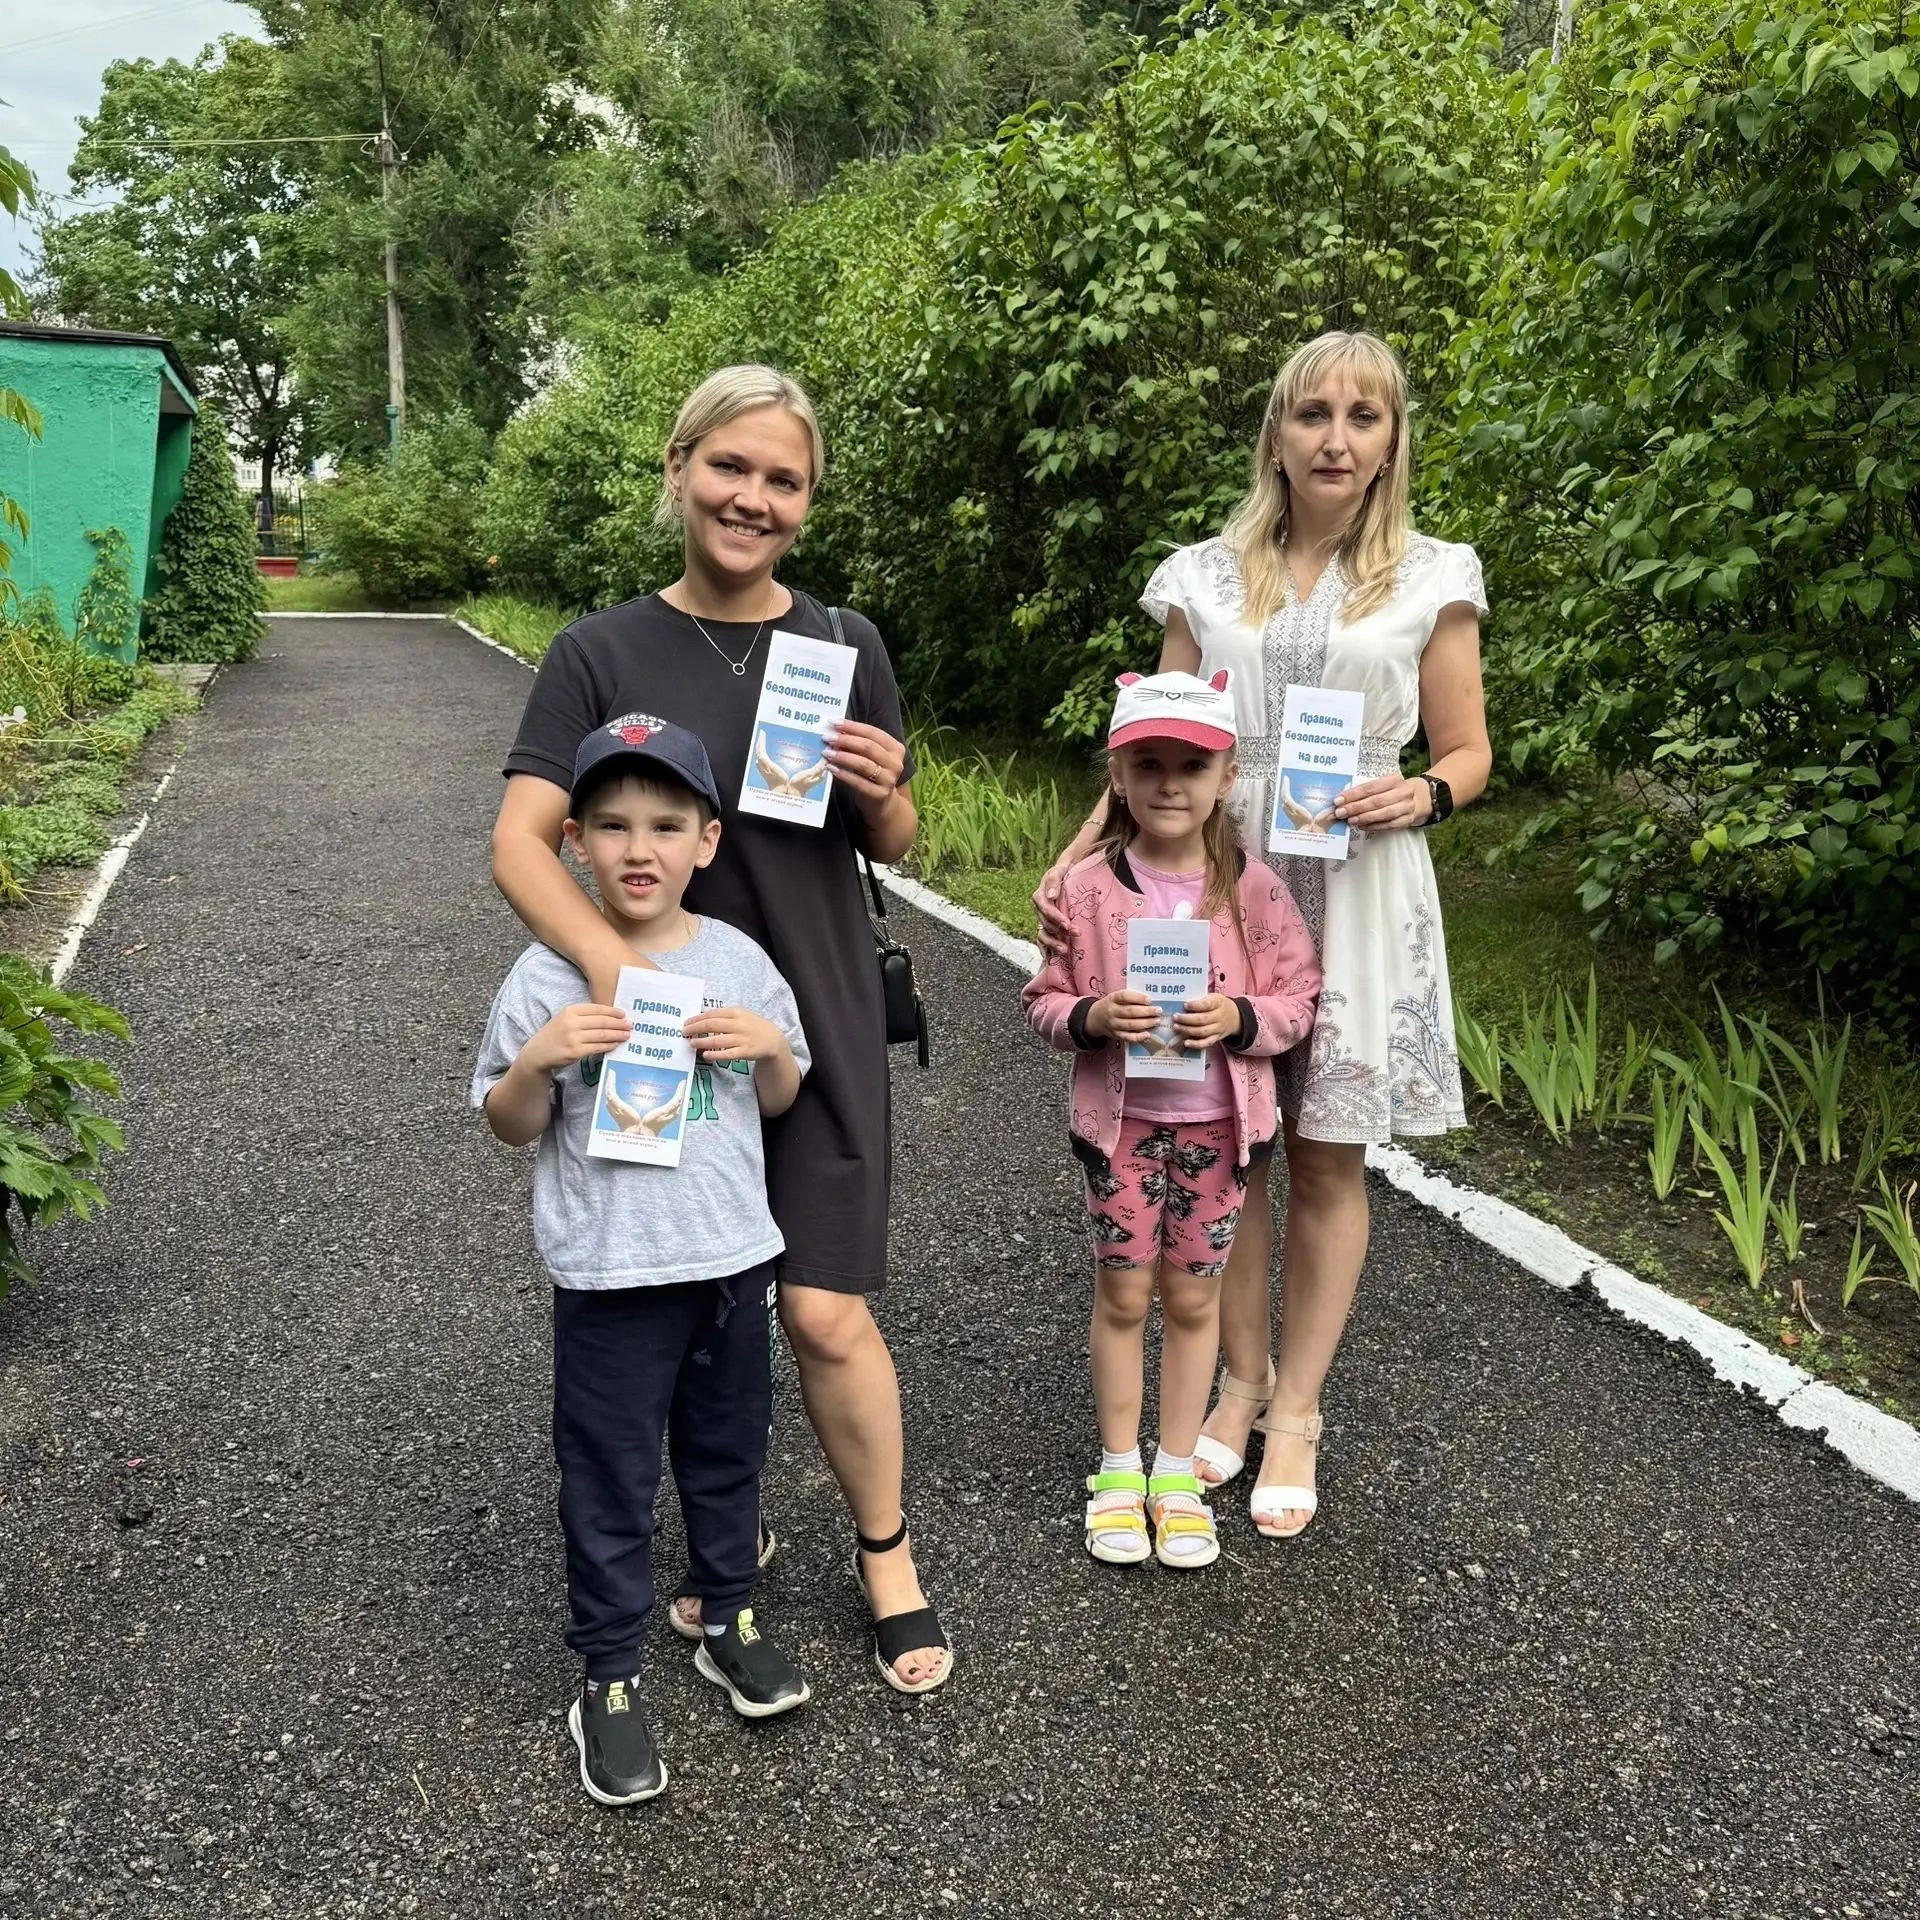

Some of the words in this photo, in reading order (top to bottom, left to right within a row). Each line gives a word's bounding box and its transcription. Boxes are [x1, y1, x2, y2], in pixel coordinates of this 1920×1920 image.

[783, 663, 831, 684] Правила
[765, 681, 841, 706] безопасности
[778, 706, 792, 719] на
[794, 710, 820, 725] воде
[1300, 712, 1343, 728] Правила
[1285, 730, 1355, 747] безопасности
[1298, 752, 1311, 762] на
[1313, 754, 1338, 766] воде
[1143, 945, 1189, 957] Правила
[1130, 964, 1203, 975] безопасности
[1145, 984, 1158, 992] на
[1161, 984, 1185, 996] воде
[632, 998, 682, 1018] Правила
[631, 1022, 692, 1039] опаснос
[627, 1042, 642, 1055] на
[645, 1047, 673, 1061] воде
